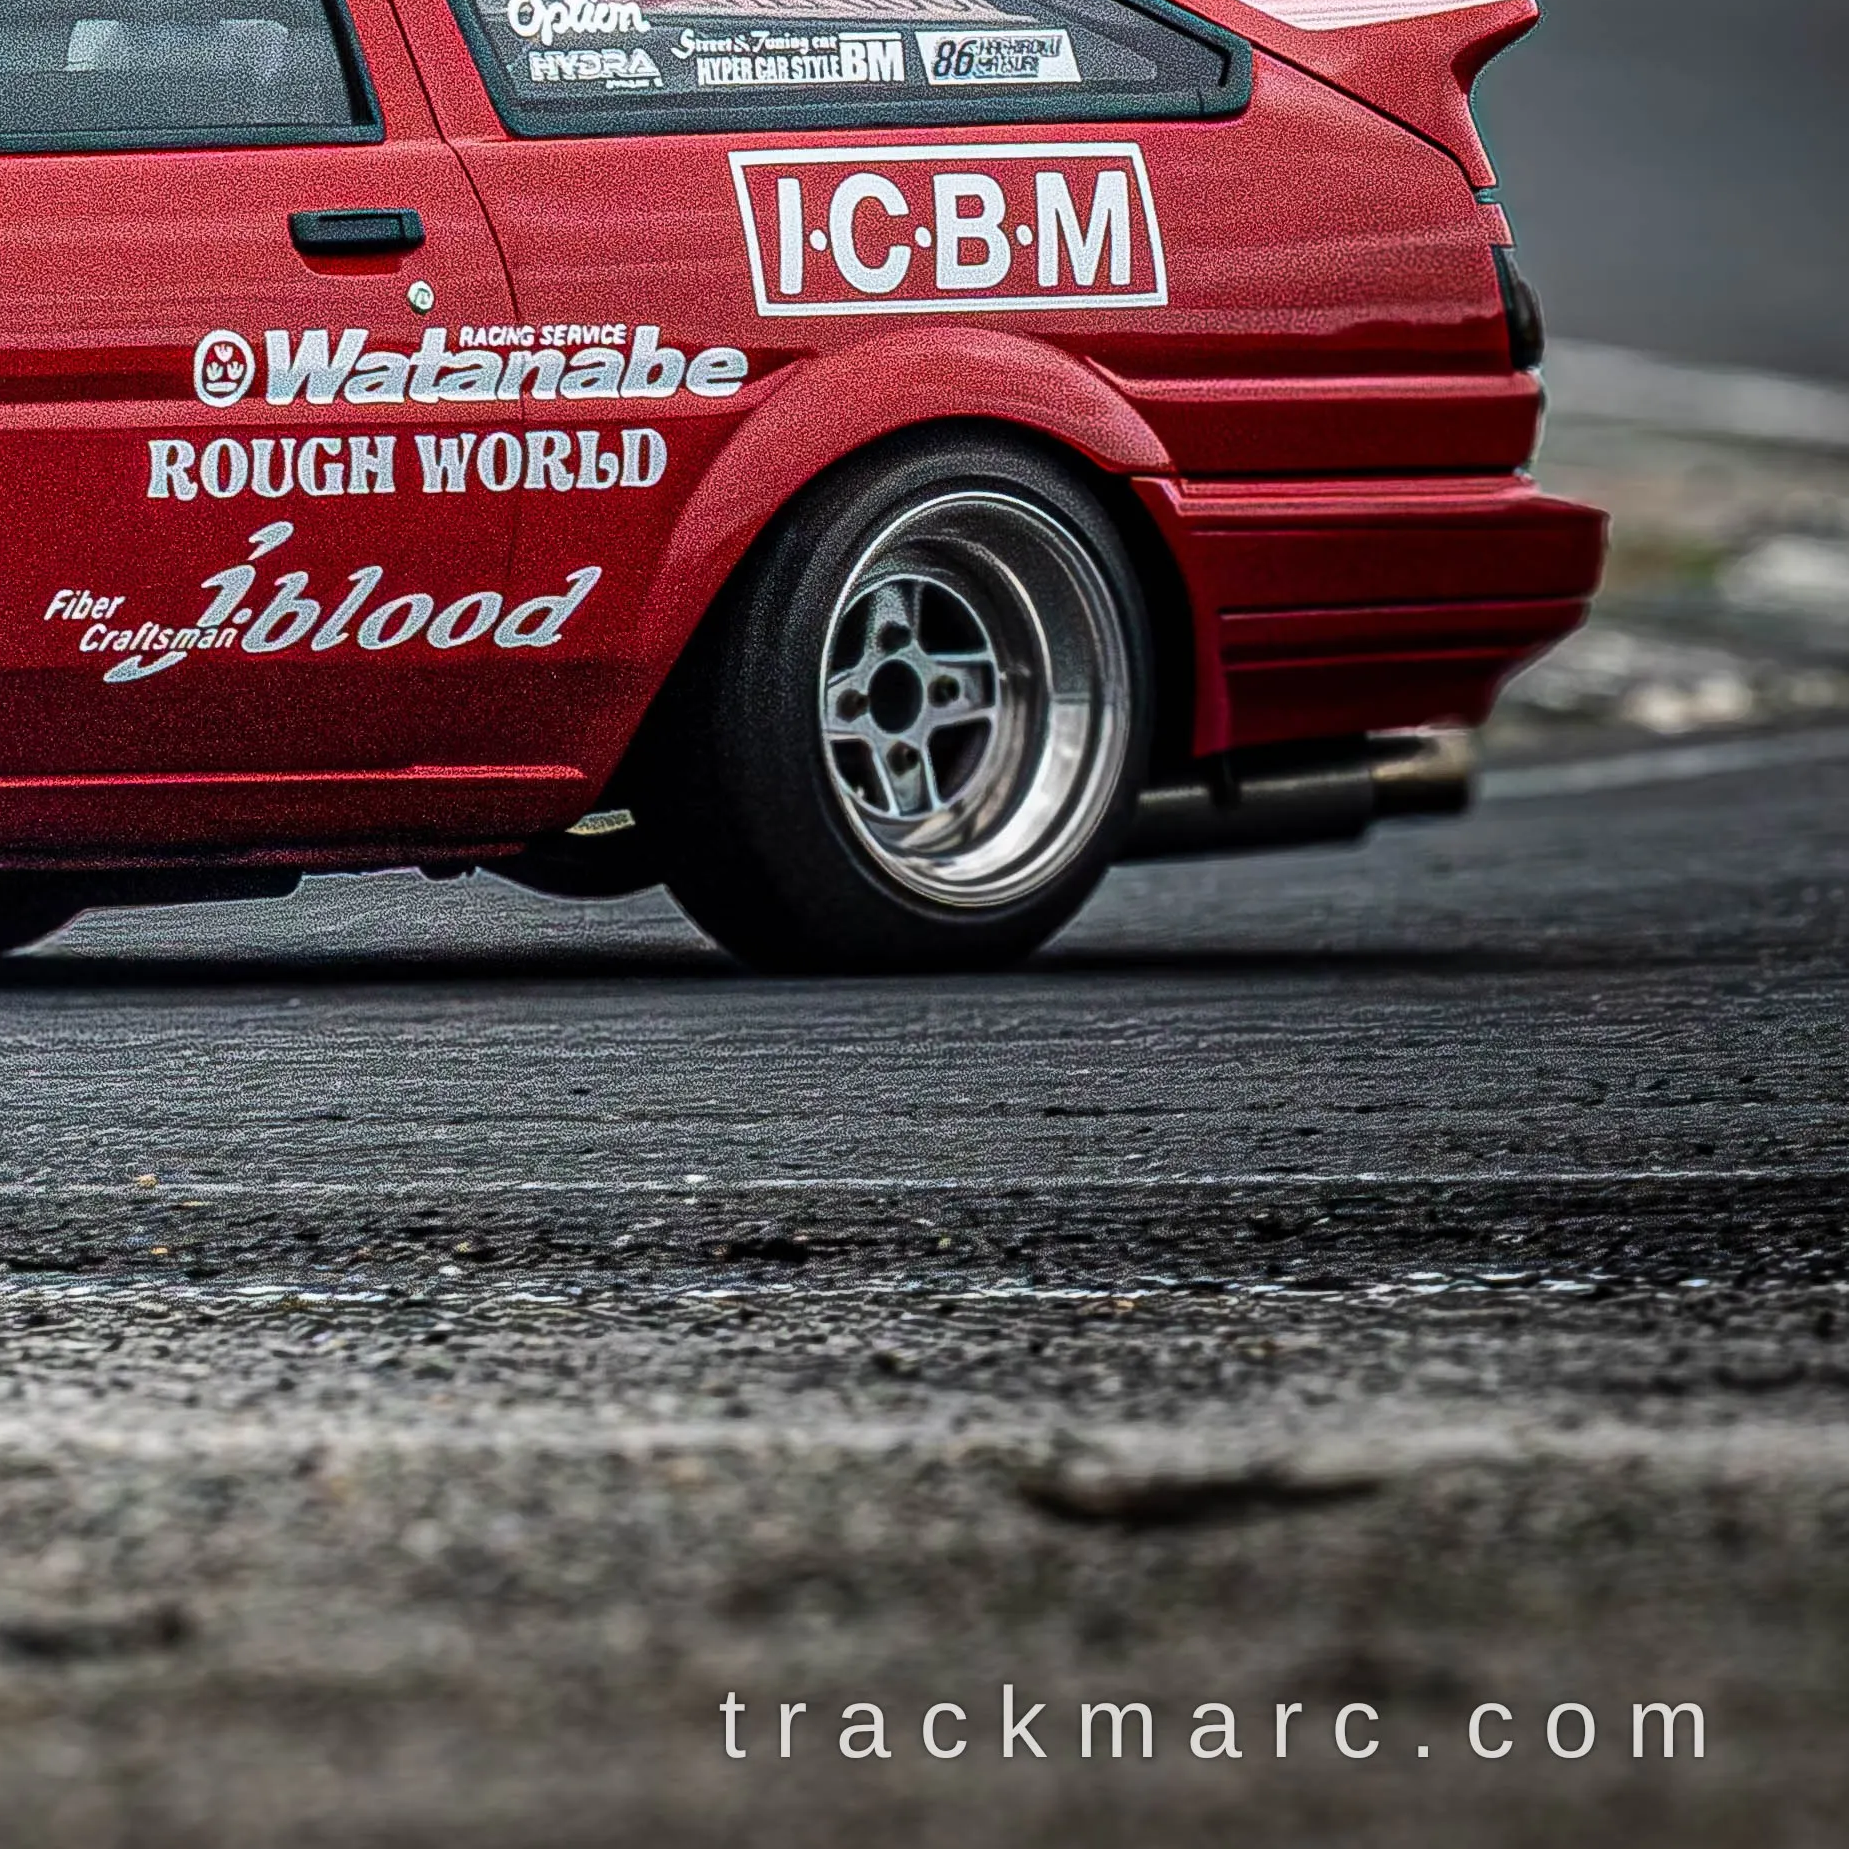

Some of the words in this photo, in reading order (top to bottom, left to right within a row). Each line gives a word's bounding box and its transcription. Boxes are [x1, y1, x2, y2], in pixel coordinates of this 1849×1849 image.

[529, 48, 661, 82] HYDRA
[697, 56, 753, 85] HYPER
[755, 56, 790, 83] CAR
[791, 54, 840, 82] STYLE
[840, 40, 905, 82] BM
[933, 39, 978, 77] 86
[458, 327, 535, 347] RACING
[538, 323, 629, 345] SERVICE
[263, 326, 750, 406] Watanabe
[145, 436, 397, 501] ROUGH
[413, 429, 669, 493] WORLD
[44, 589, 125, 621] Fiber
[78, 622, 238, 653] Craftsman
